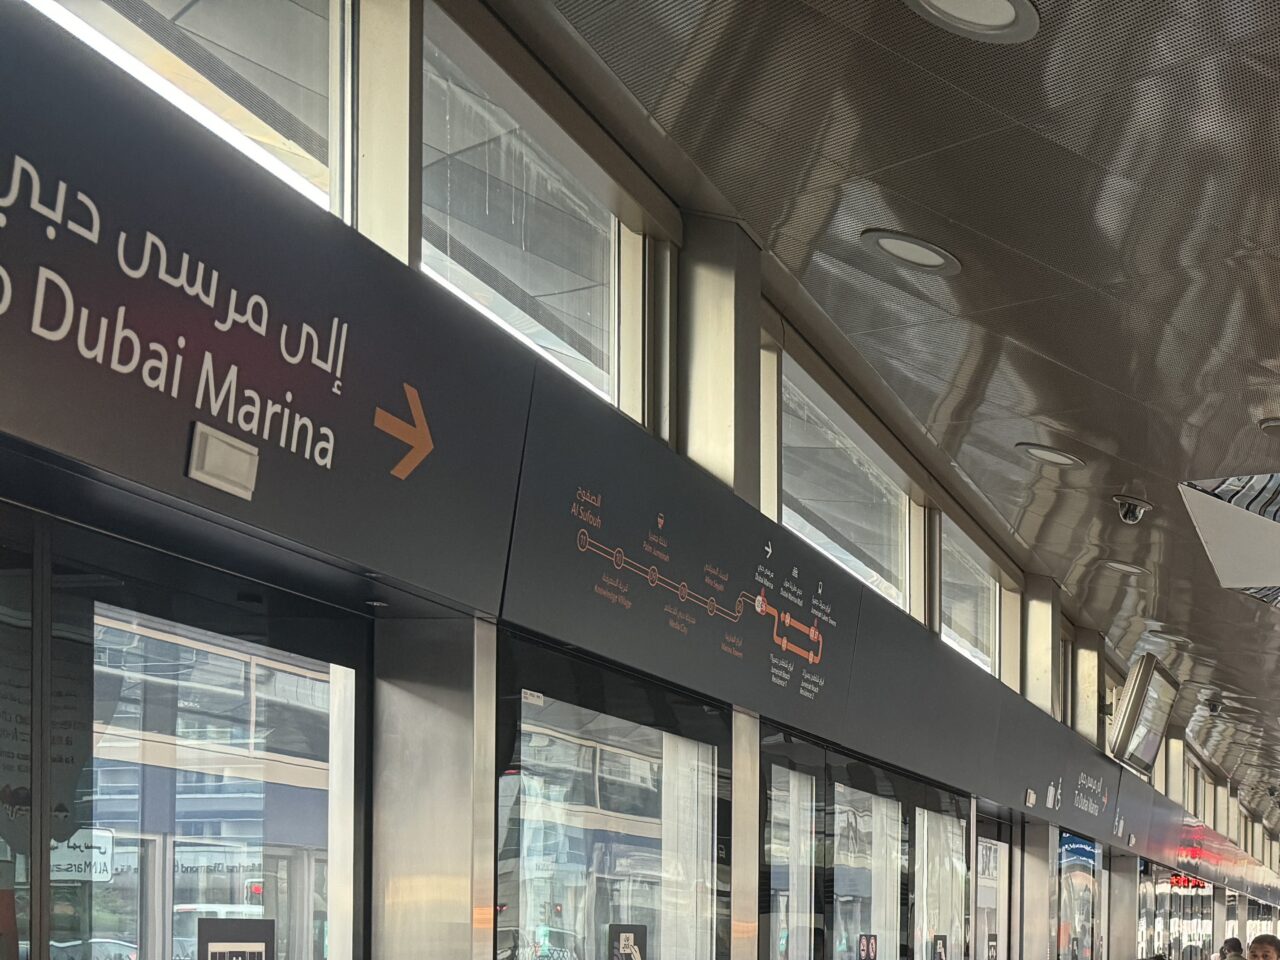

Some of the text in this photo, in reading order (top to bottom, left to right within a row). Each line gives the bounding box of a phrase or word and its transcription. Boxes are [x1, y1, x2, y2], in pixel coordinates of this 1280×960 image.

[117, 231, 269, 337] مرسى
[31, 266, 186, 399] Dubai
[194, 351, 336, 469] Marina
[280, 317, 348, 395] إلى
